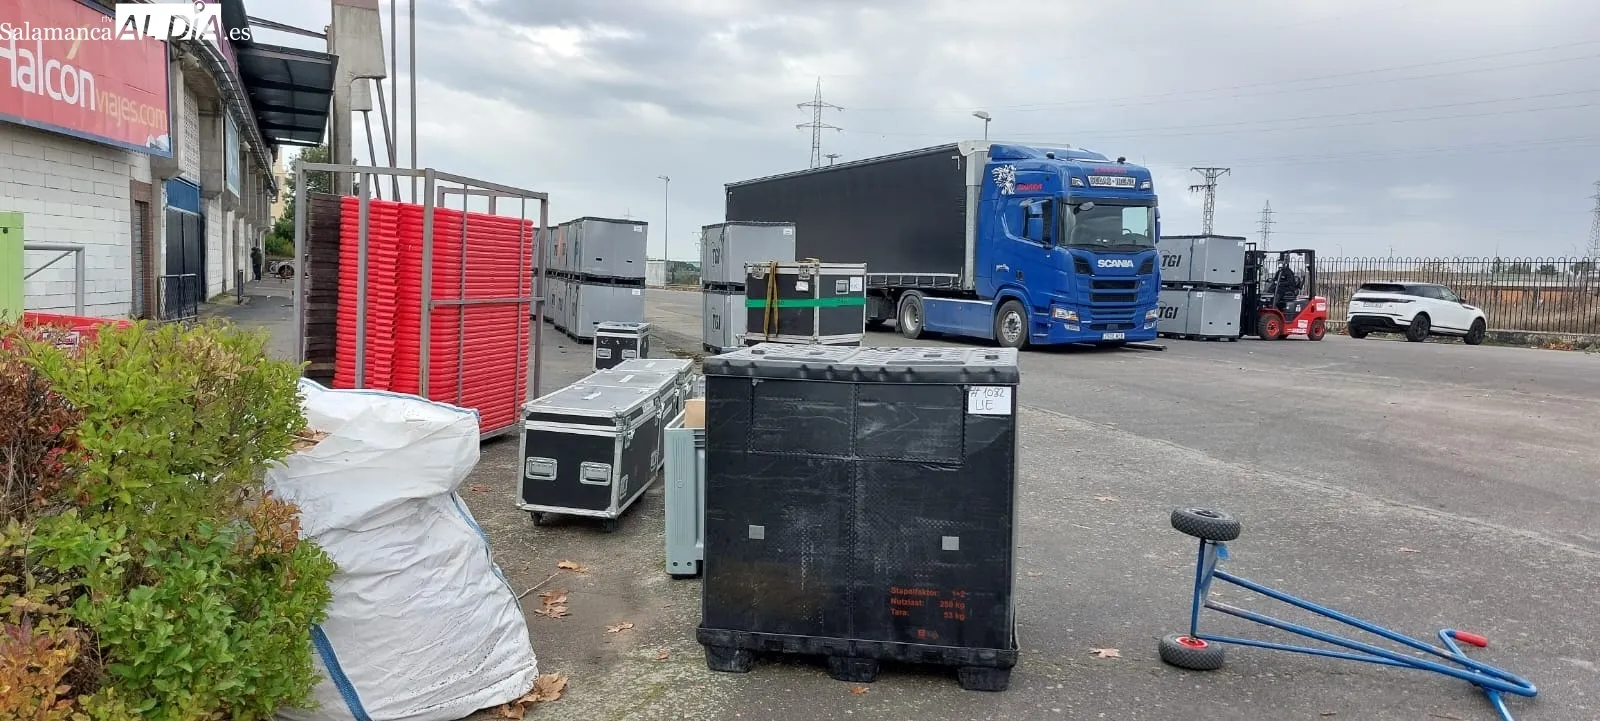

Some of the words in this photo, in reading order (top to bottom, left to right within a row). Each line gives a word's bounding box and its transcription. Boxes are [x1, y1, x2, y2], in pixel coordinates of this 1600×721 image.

[1097, 259, 1133, 268] SCANIA
[1162, 255, 1182, 267] TGI
[1159, 307, 1179, 319] TGI
